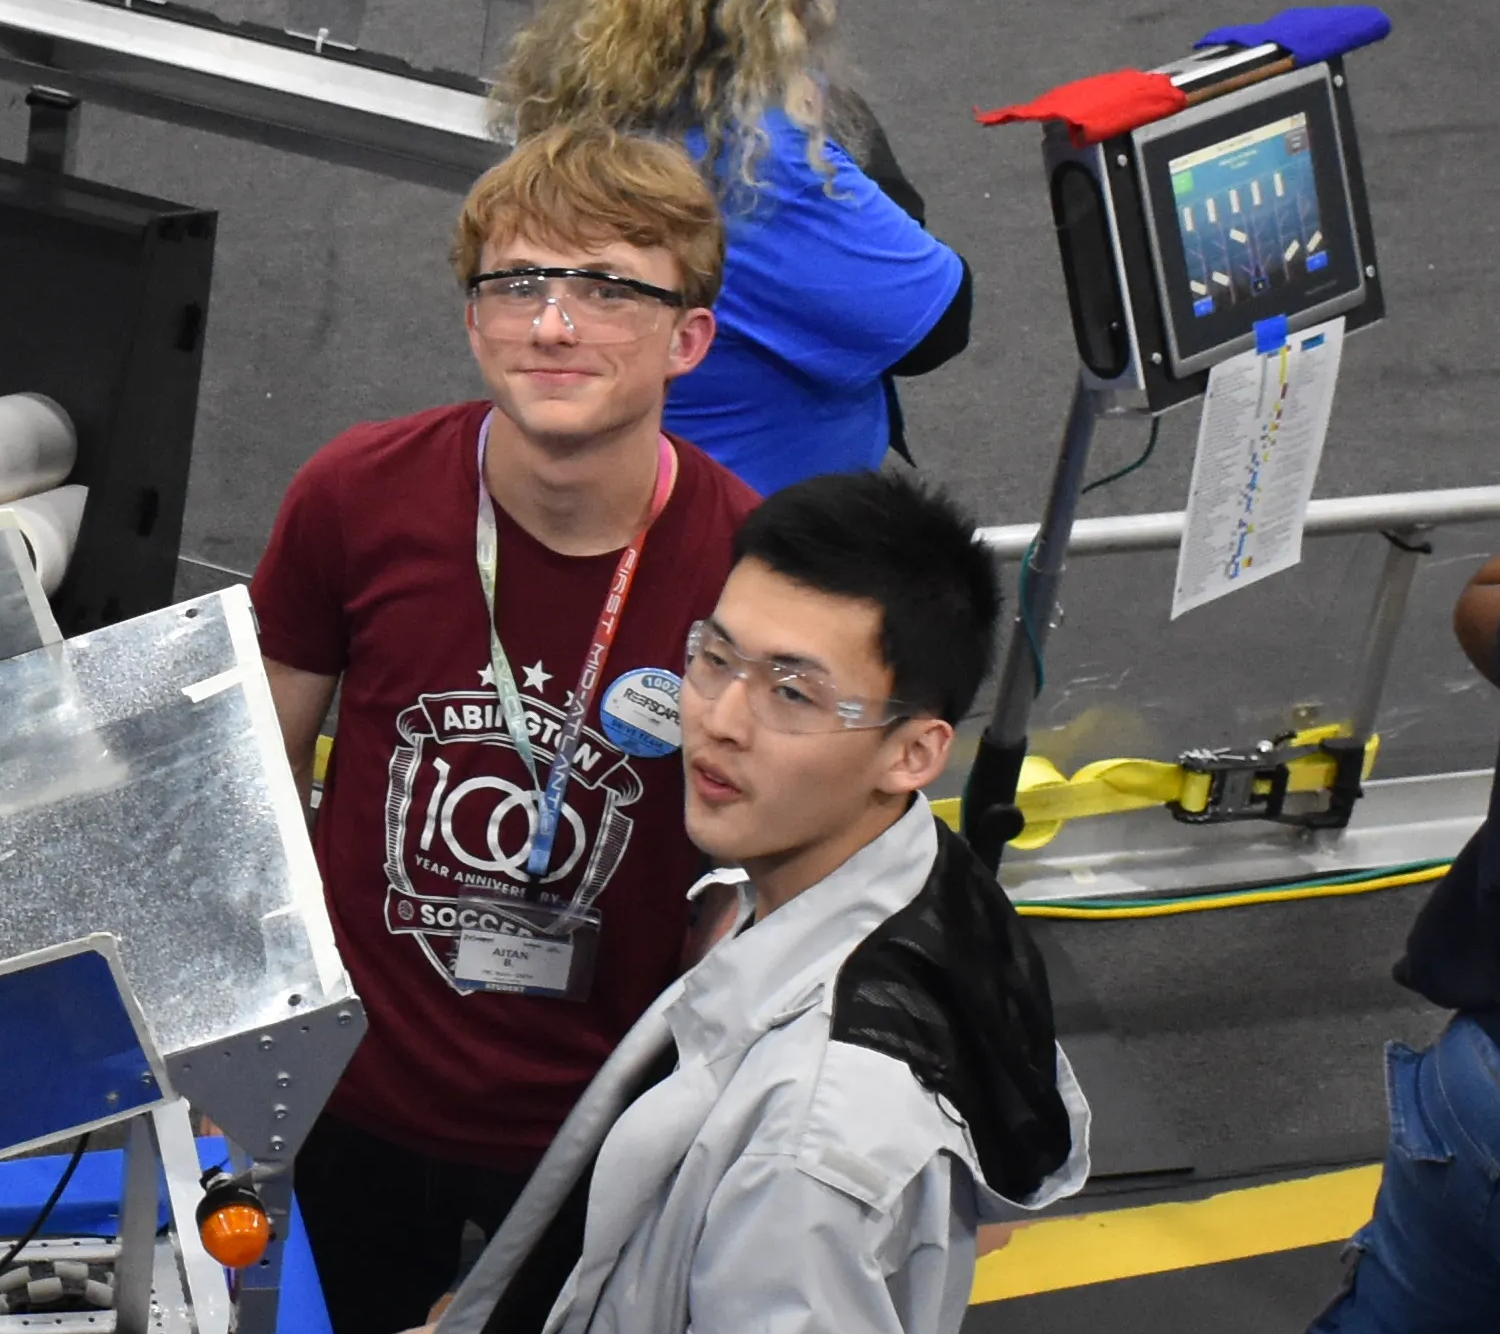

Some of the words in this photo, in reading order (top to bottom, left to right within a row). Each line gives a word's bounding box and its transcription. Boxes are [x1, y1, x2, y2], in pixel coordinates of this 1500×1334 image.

[601, 547, 637, 635] FIRST
[420, 756, 587, 884] 100
[415, 854, 449, 878] YEAR
